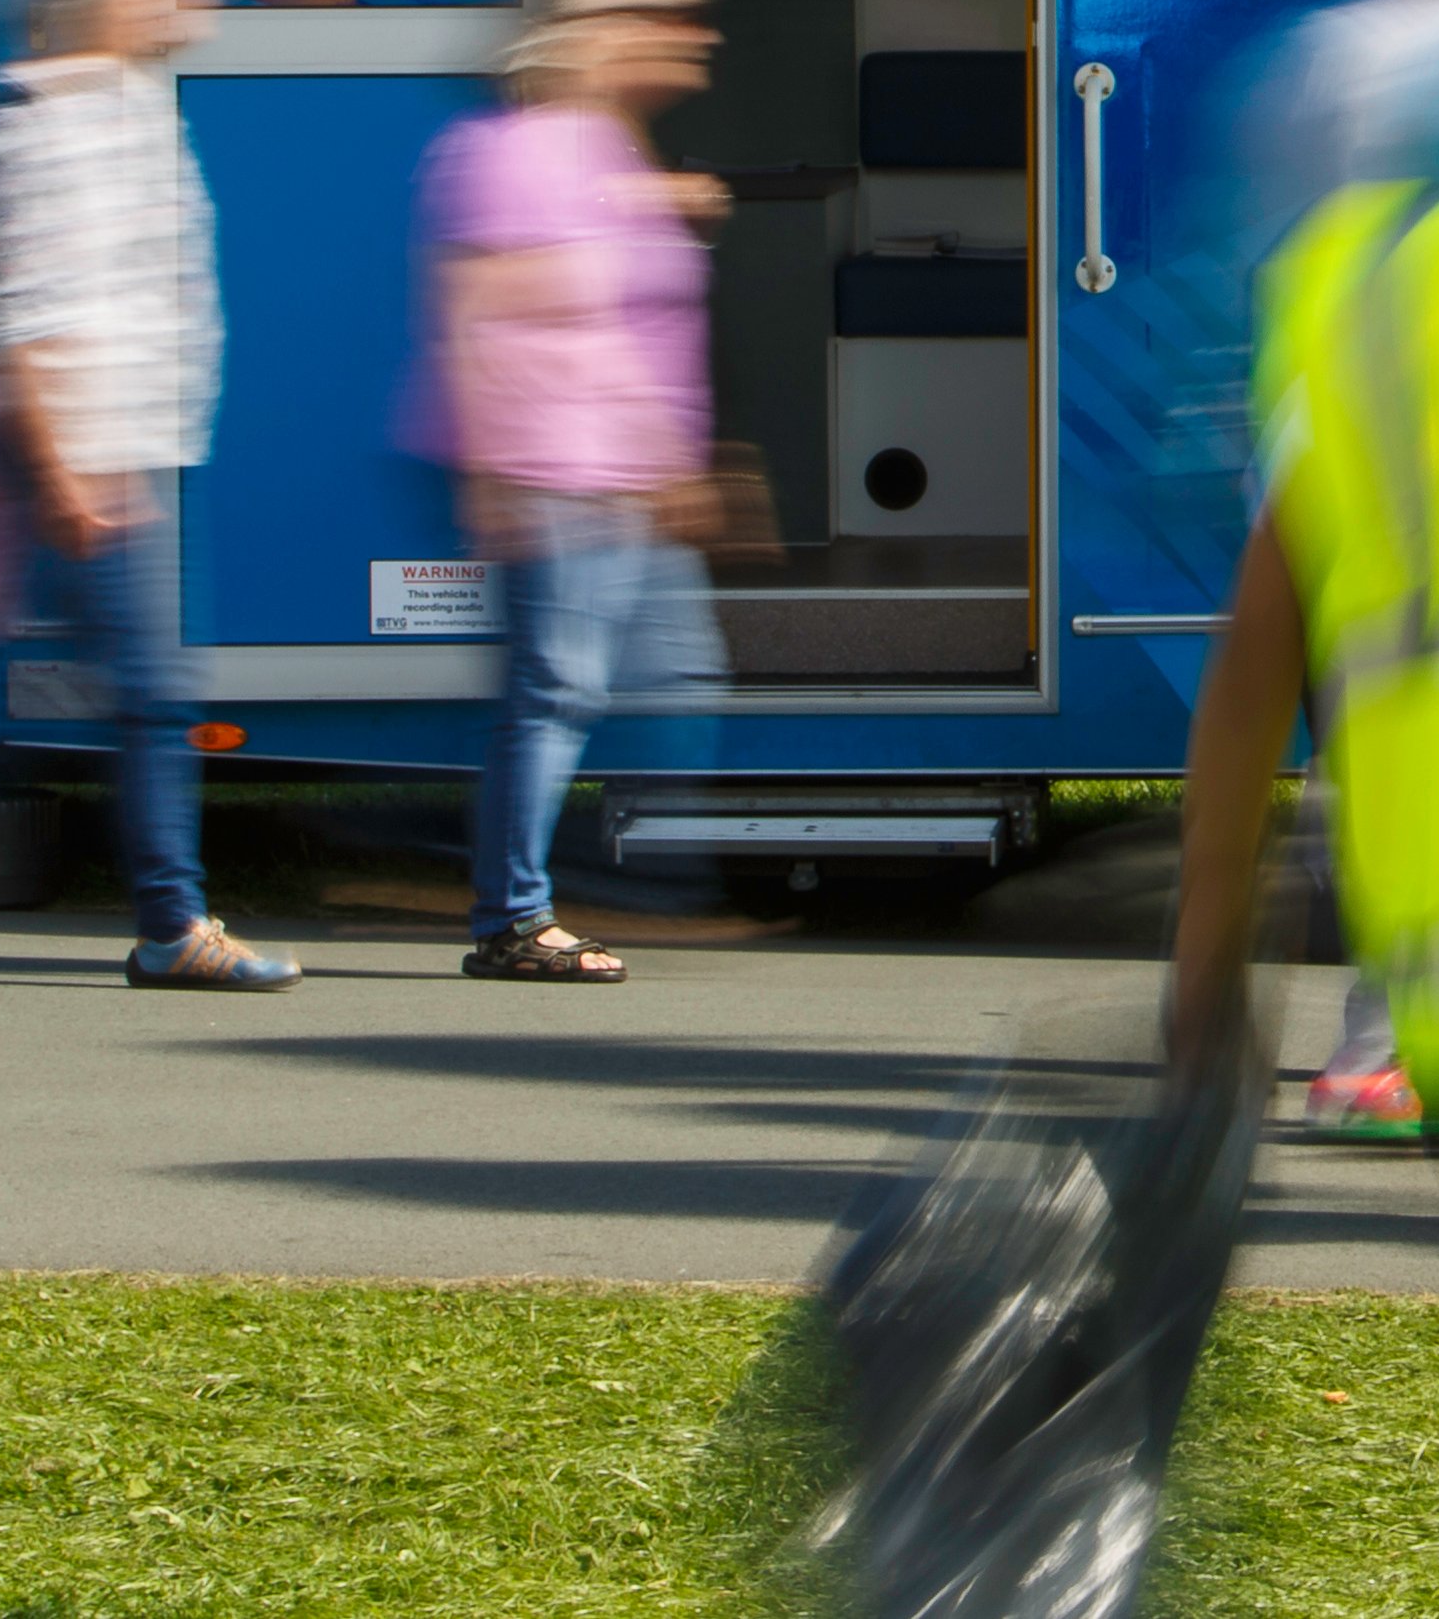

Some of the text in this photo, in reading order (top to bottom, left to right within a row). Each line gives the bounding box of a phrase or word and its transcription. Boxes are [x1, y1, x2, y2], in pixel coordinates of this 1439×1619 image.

[402, 566, 486, 579] WARNING
[408, 589, 479, 599] This vehicle is
[403, 603, 484, 613] recording audio
